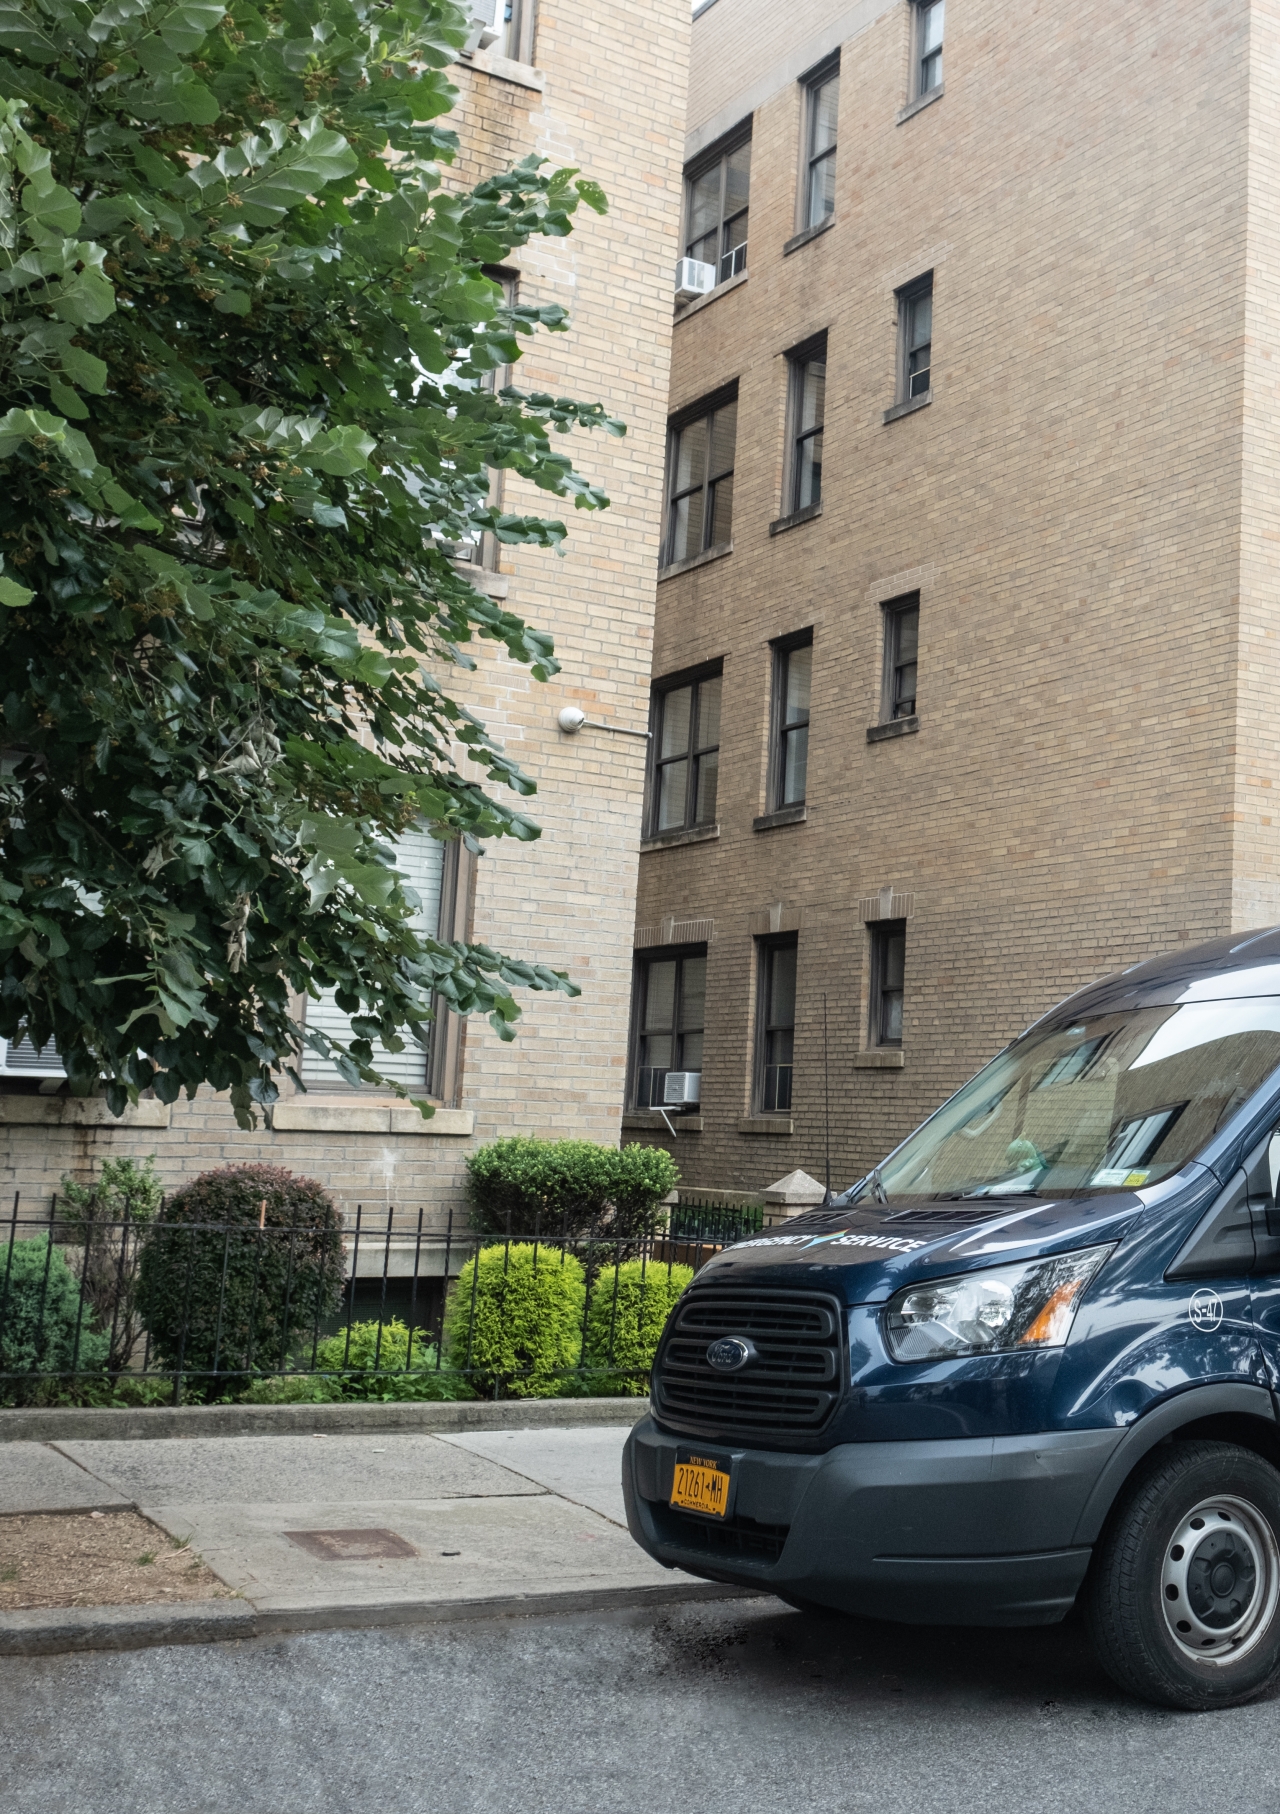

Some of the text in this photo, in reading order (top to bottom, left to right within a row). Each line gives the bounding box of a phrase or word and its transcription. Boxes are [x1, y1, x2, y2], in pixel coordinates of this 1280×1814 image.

[830, 1234, 928, 1253] SERVICE
[1193, 1298, 1218, 1323] S-47
[690, 1455, 717, 1469] NEW YORK
